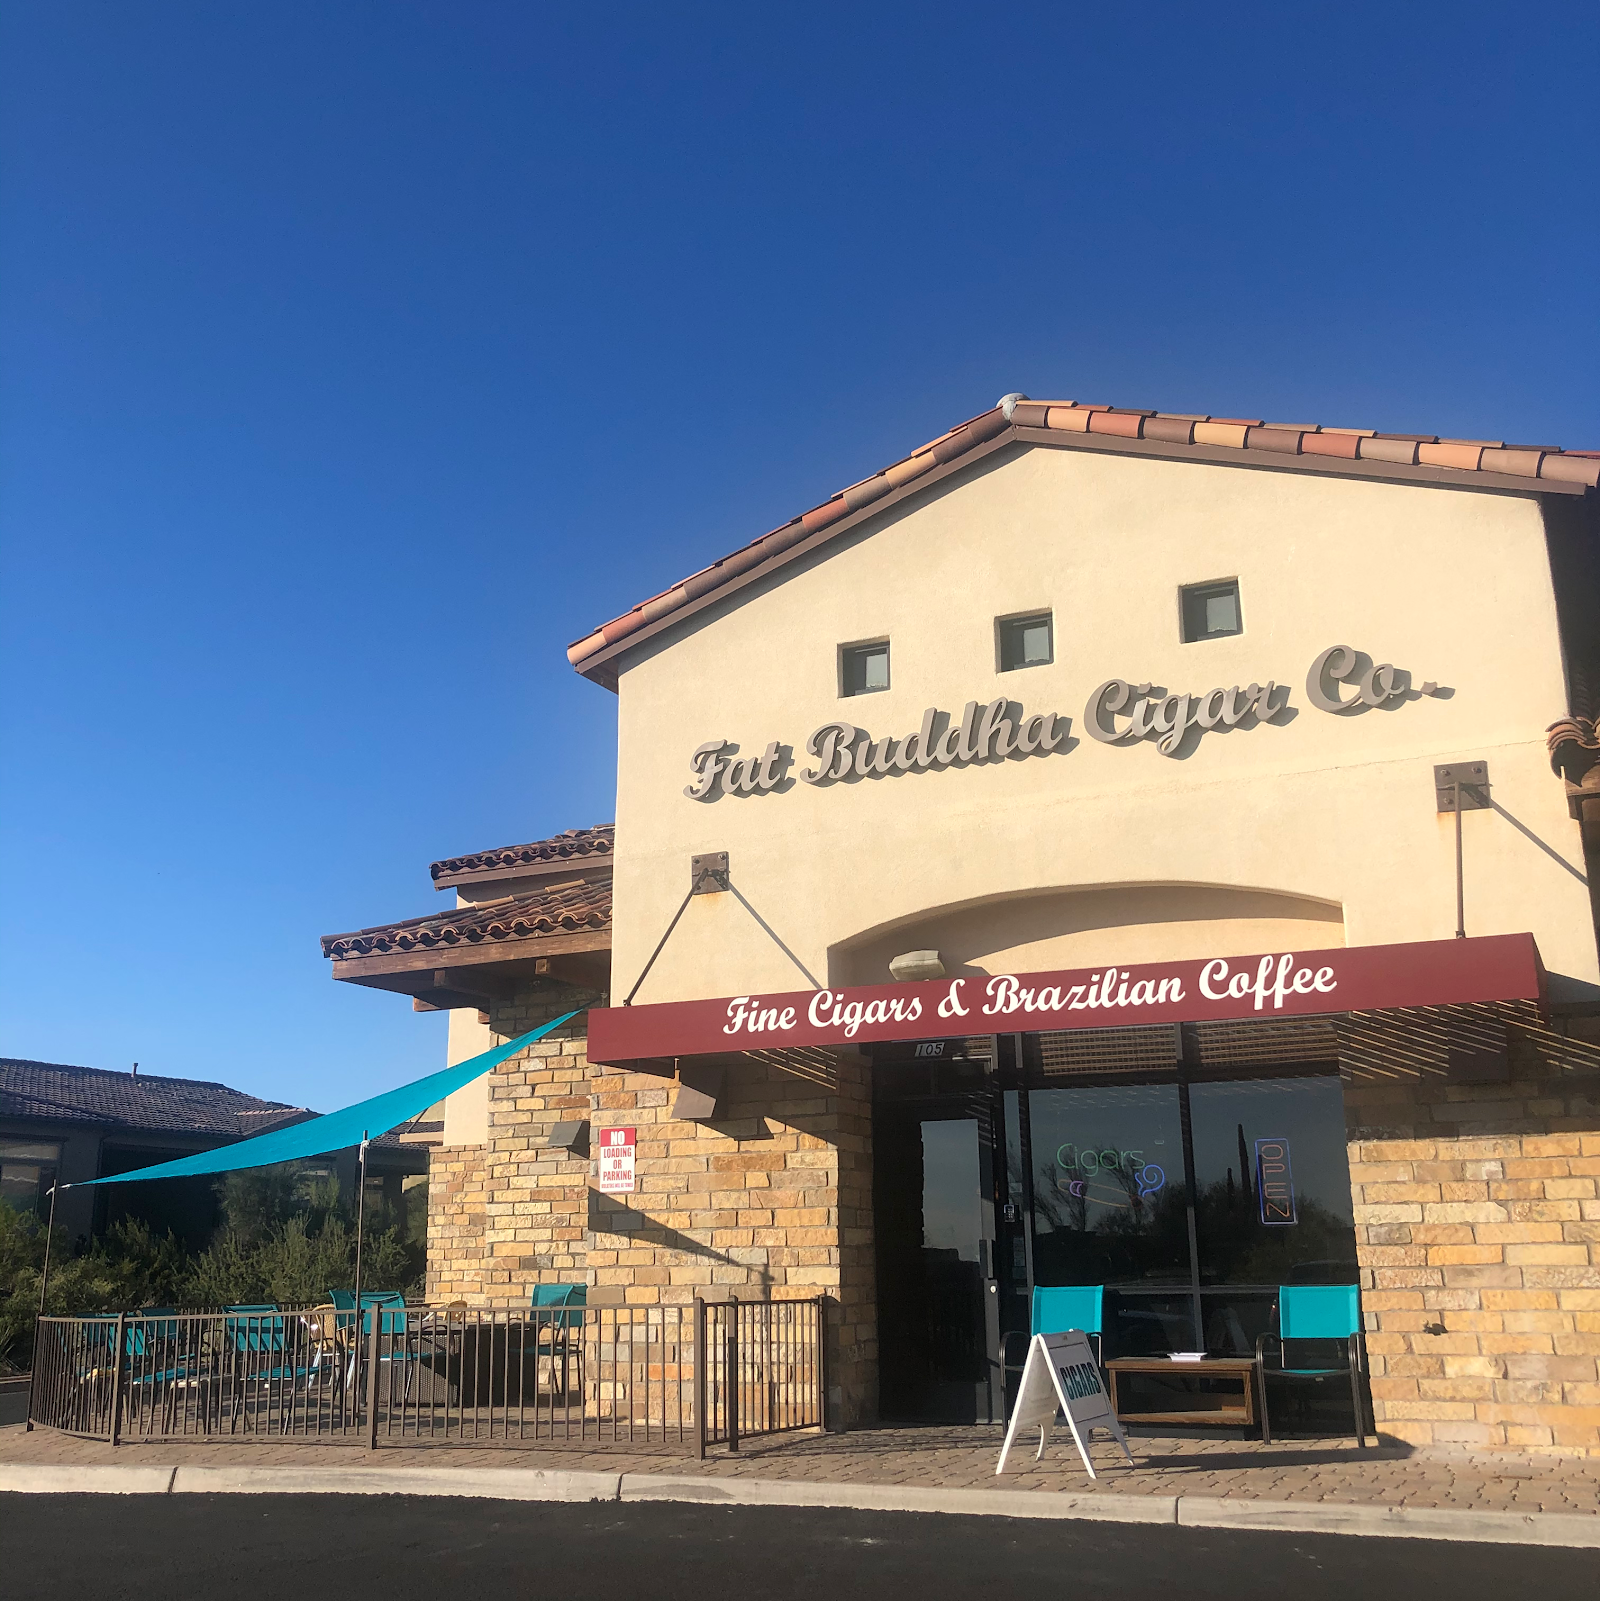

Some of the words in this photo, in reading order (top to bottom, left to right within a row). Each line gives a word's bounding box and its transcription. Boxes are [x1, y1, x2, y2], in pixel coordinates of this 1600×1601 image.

[683, 739, 785, 800] Fat
[800, 697, 1064, 781] Buddha
[1083, 679, 1285, 755] Cigar
[1306, 645, 1438, 712] Co.
[723, 997, 797, 1035] Fine
[808, 989, 923, 1038] Cigars
[937, 979, 970, 1018] &
[981, 967, 1186, 1016] Brazilian
[1198, 953, 1338, 1011] Coffee
[917, 1043, 943, 1056] 105
[610, 1131, 625, 1145] NO
[603, 1147, 632, 1158] LOADING
[613, 1159, 622, 1169] OR
[1056, 1143, 1146, 1177] Cigars
[603, 1170, 632, 1181] PARKING
[1261, 1144, 1290, 1218] OPEN
[1059, 1362, 1101, 1400] CIGARS
